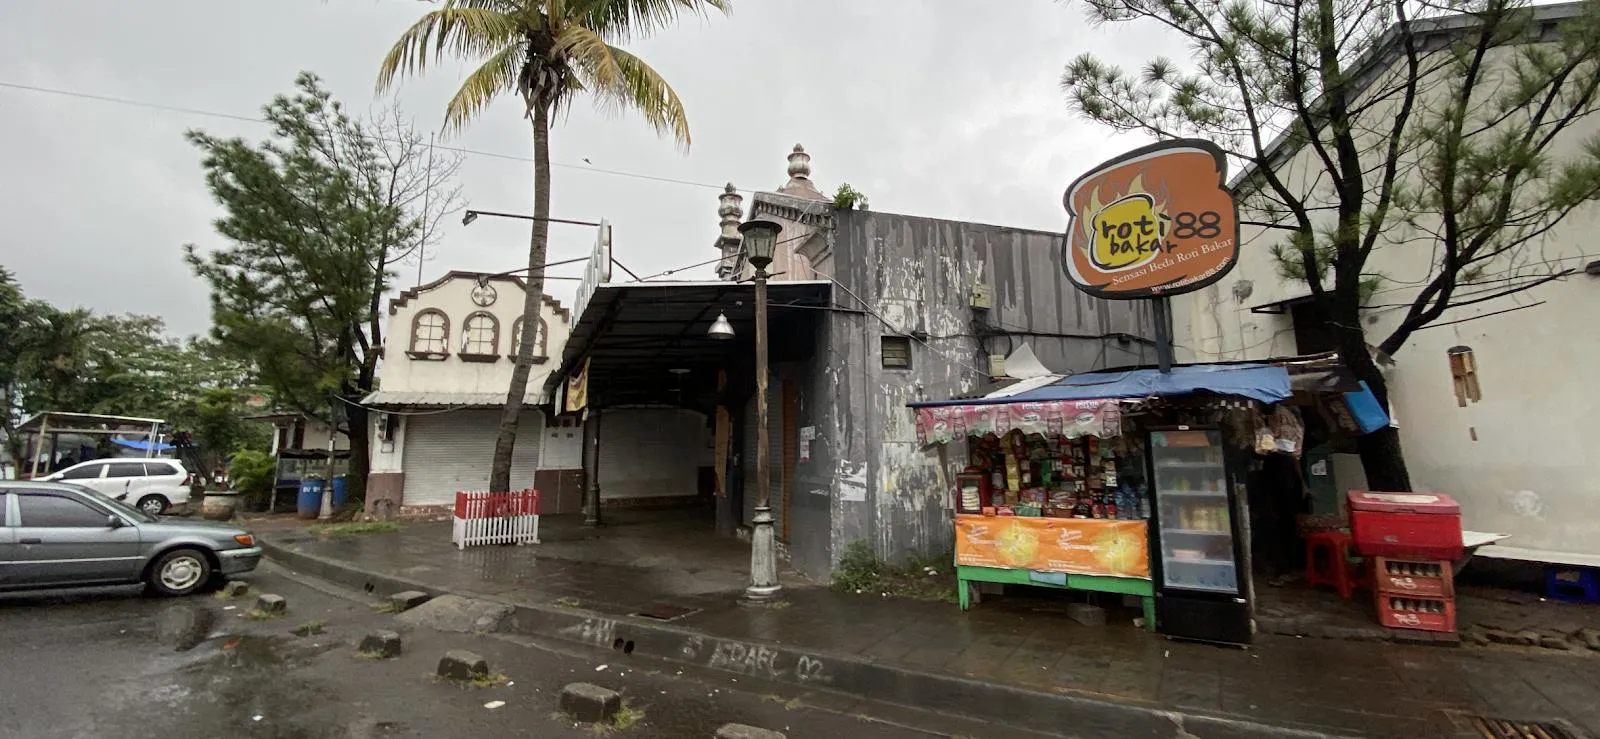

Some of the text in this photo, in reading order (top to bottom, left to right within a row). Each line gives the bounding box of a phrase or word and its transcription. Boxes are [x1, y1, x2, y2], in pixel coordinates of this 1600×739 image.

[1101, 211, 1221, 239] roti 88
[1110, 234, 1178, 255] bakar
[1112, 238, 1233, 285] Sensasi Beda Roti Bakar
[1151, 256, 1231, 292] www.rotibakar88.com
